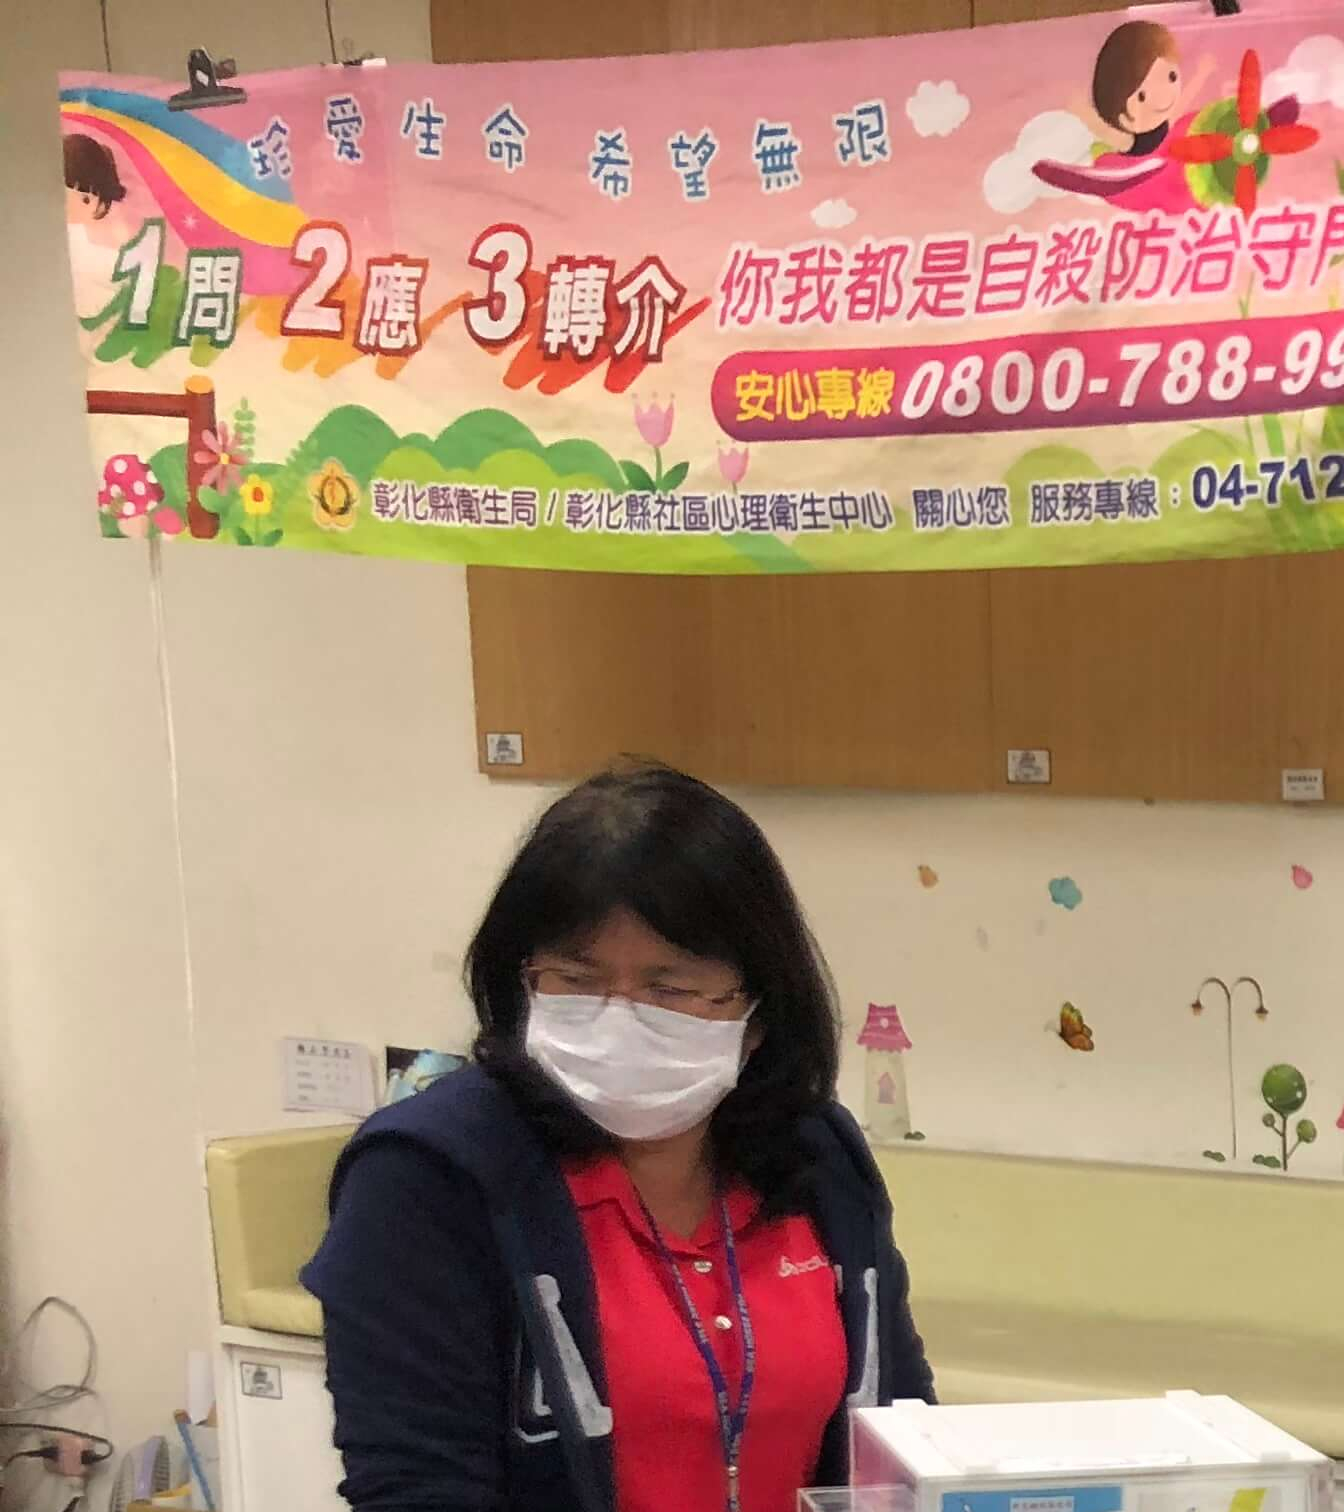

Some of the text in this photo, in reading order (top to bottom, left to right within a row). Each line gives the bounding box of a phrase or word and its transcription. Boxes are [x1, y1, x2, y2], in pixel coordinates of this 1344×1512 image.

[735, 367, 895, 423] 安心專線
[373, 483, 537, 527] 彰化縣衛生局
[565, 491, 894, 531] 彰化縣社區心理衛生中心
[912, 486, 1009, 528] 關心您
